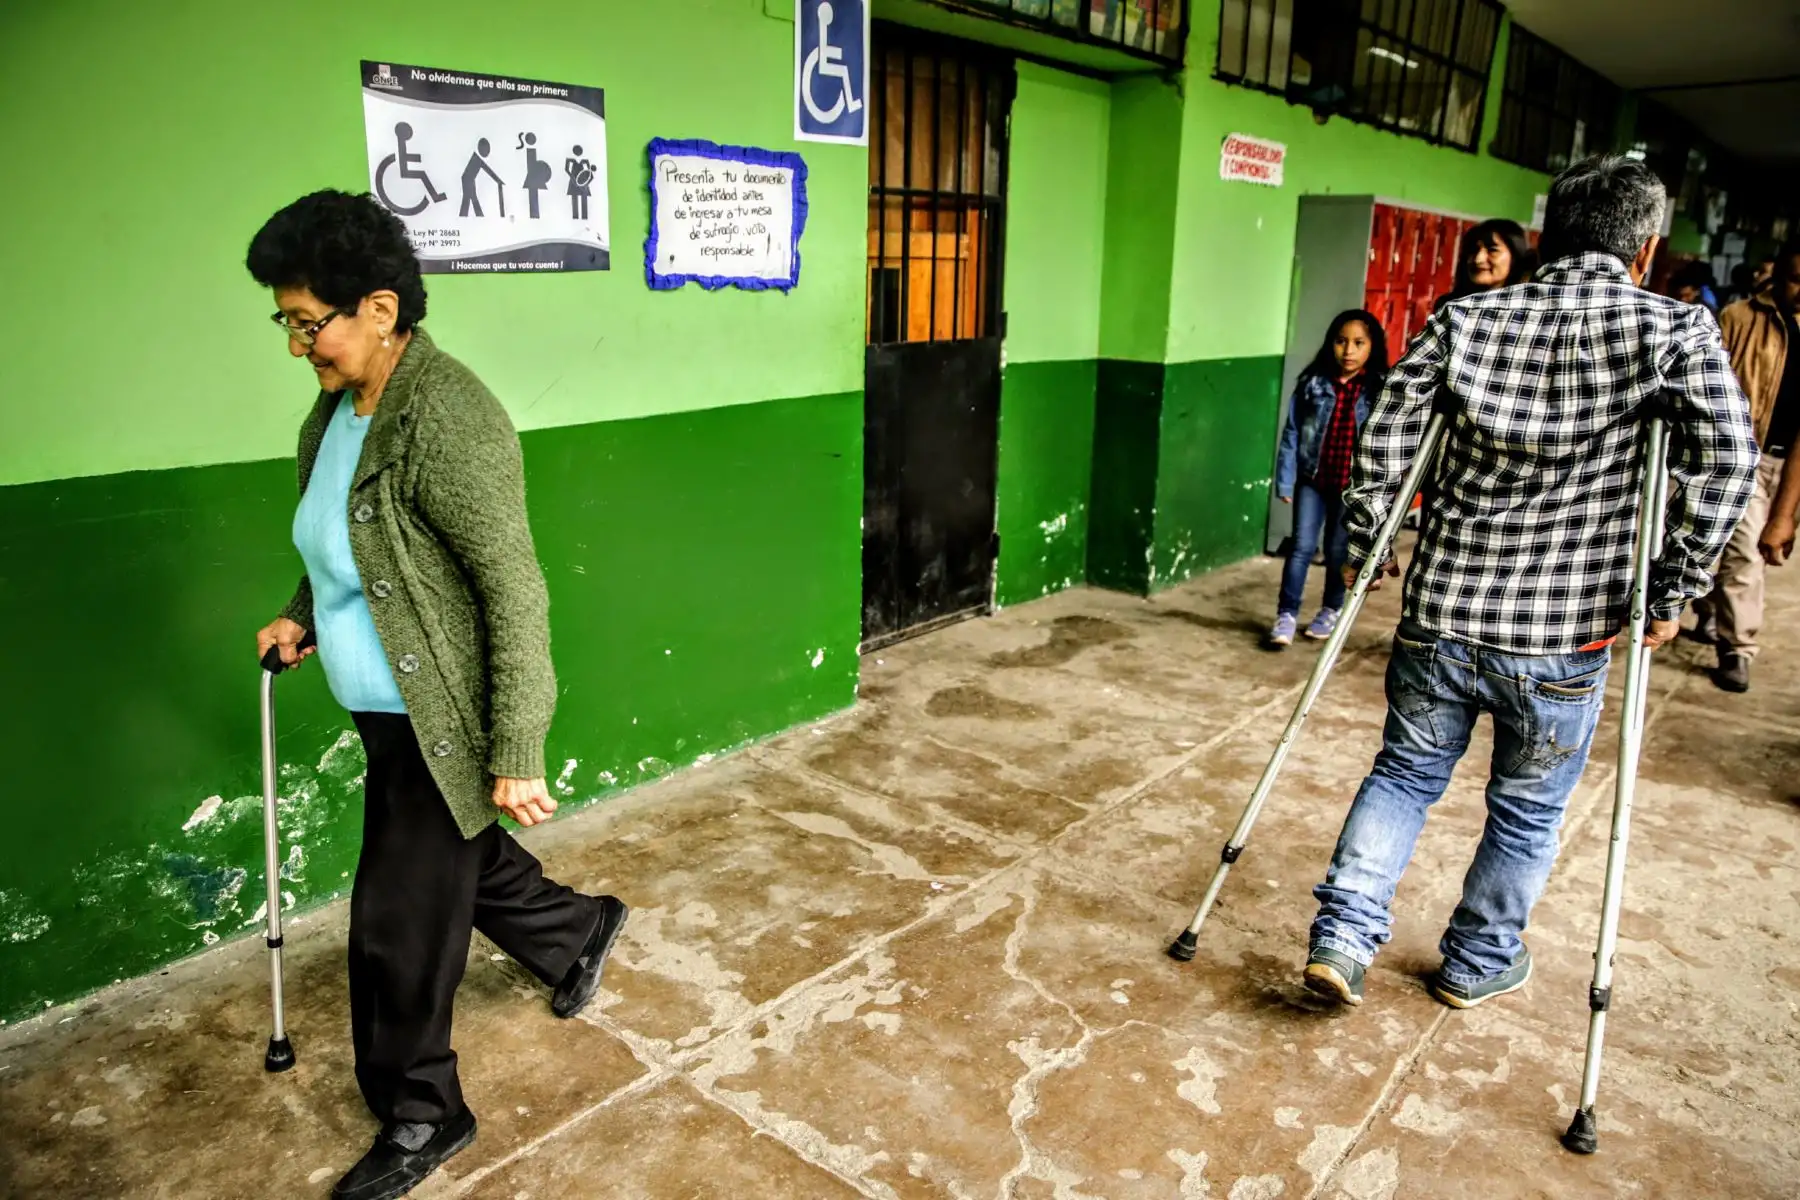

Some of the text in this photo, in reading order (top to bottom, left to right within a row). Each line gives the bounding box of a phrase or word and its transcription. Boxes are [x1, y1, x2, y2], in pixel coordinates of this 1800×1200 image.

[411, 69, 568, 97] No olvidemos que ellos son primero:
[659, 159, 787, 185] Presenta tu documento
[682, 188, 764, 203] de identidad antes
[674, 205, 773, 228] de ingresar a tu mesa
[413, 229, 426, 238] Ley
[689, 224, 701, 240] de
[414, 239, 427, 248] Ley
[700, 242, 755, 262] responsable
[456, 261, 491, 270] Hacemos
[492, 262, 507, 271] que
